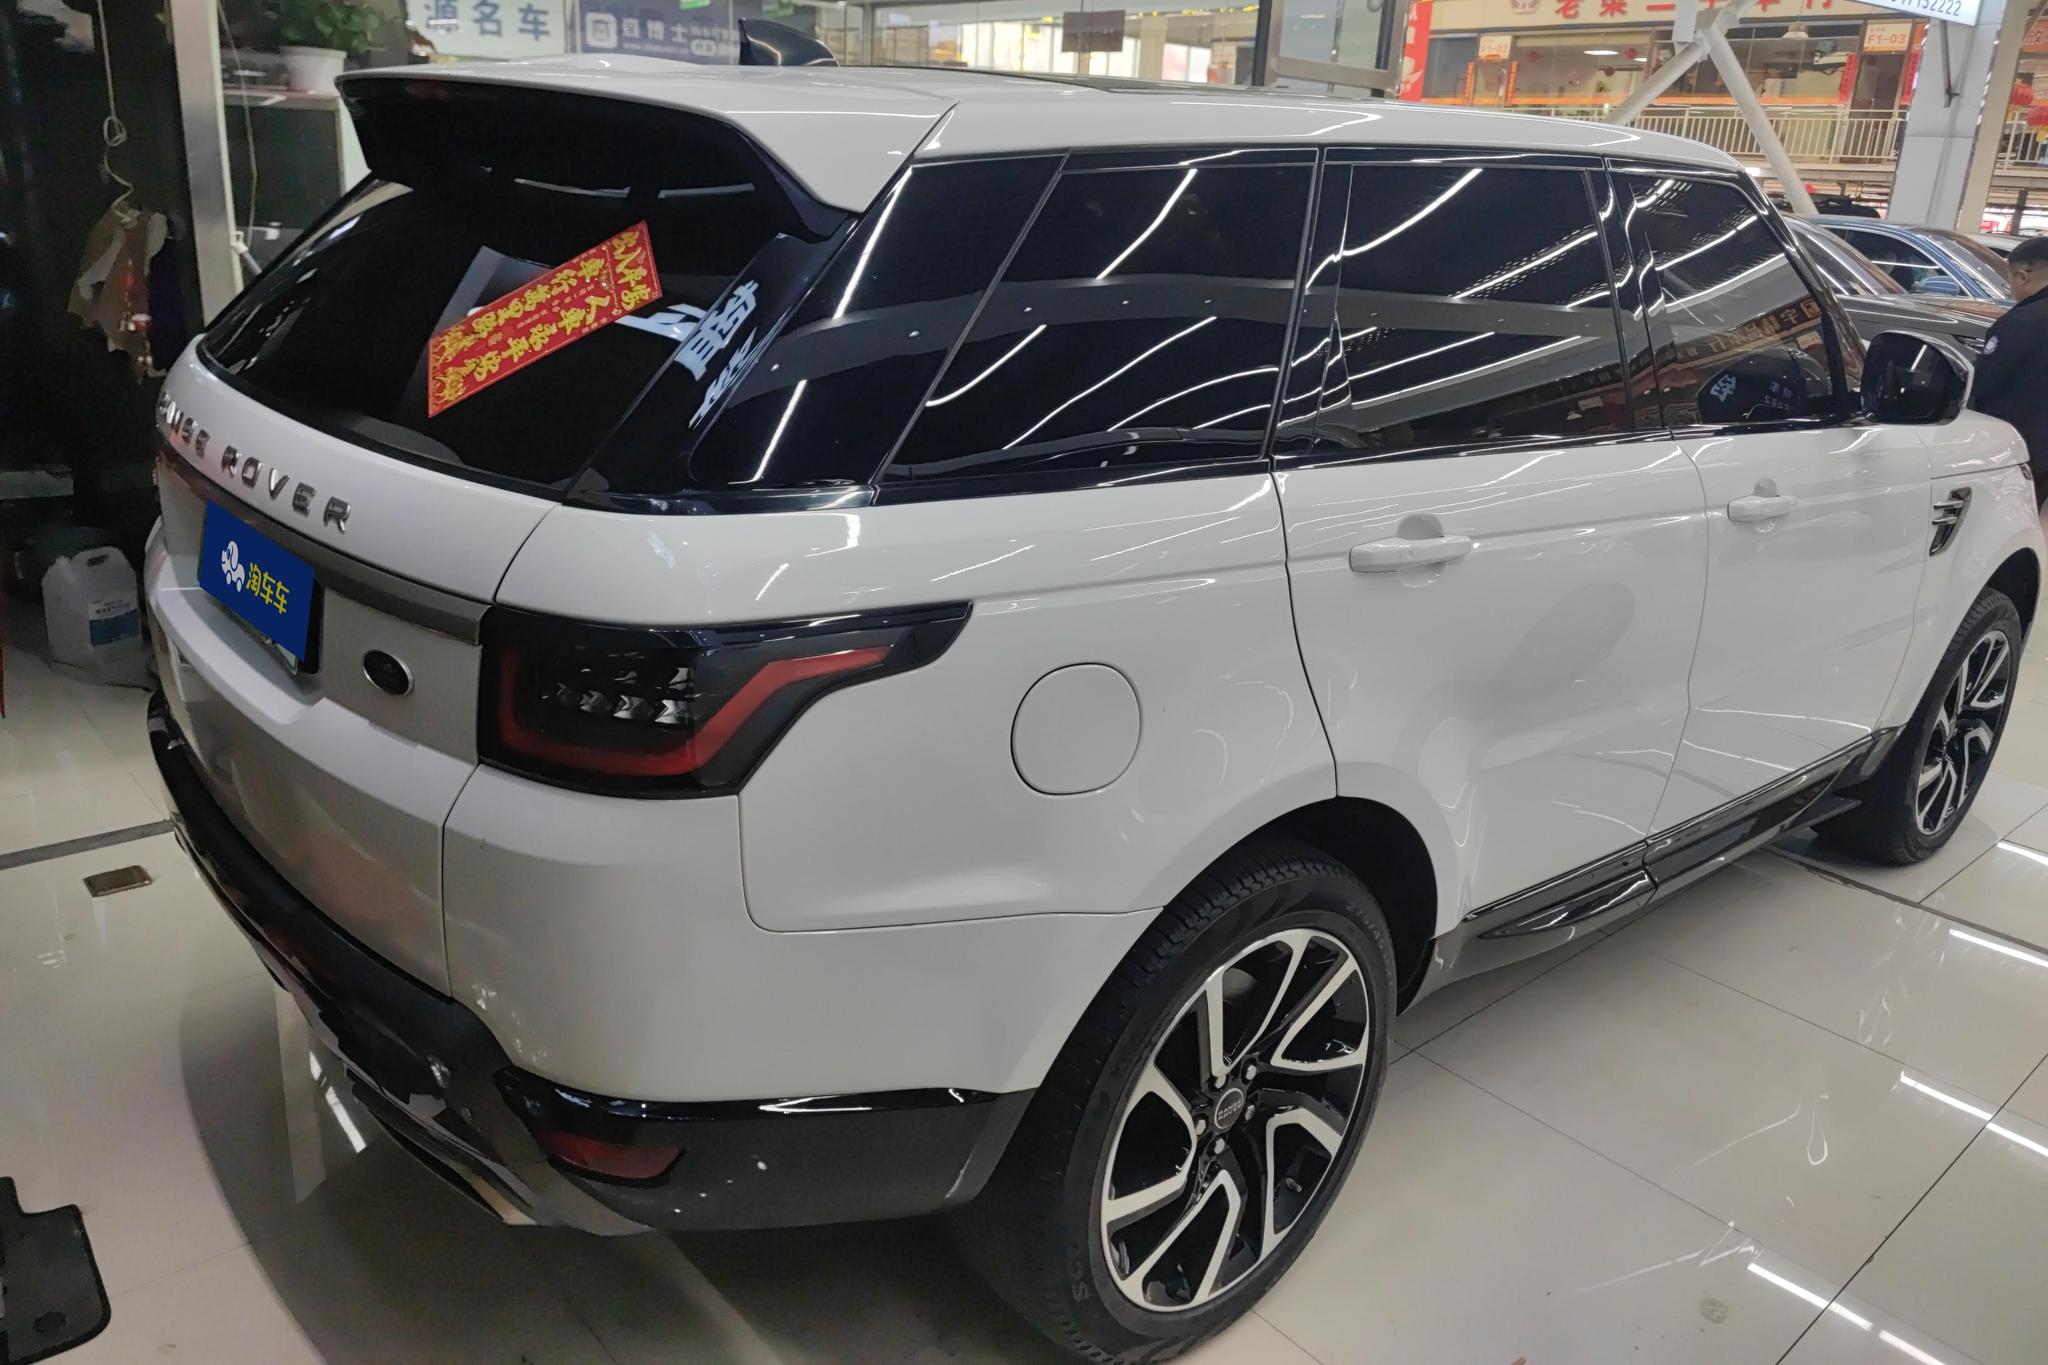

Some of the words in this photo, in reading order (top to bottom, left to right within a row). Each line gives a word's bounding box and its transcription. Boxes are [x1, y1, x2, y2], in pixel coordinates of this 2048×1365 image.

[1867, 33, 1906, 45] F1-03
[221, 445, 352, 534] ROVER
[1218, 1098, 1241, 1115] RANGE
[1218, 1103, 1241, 1121] ROVER
